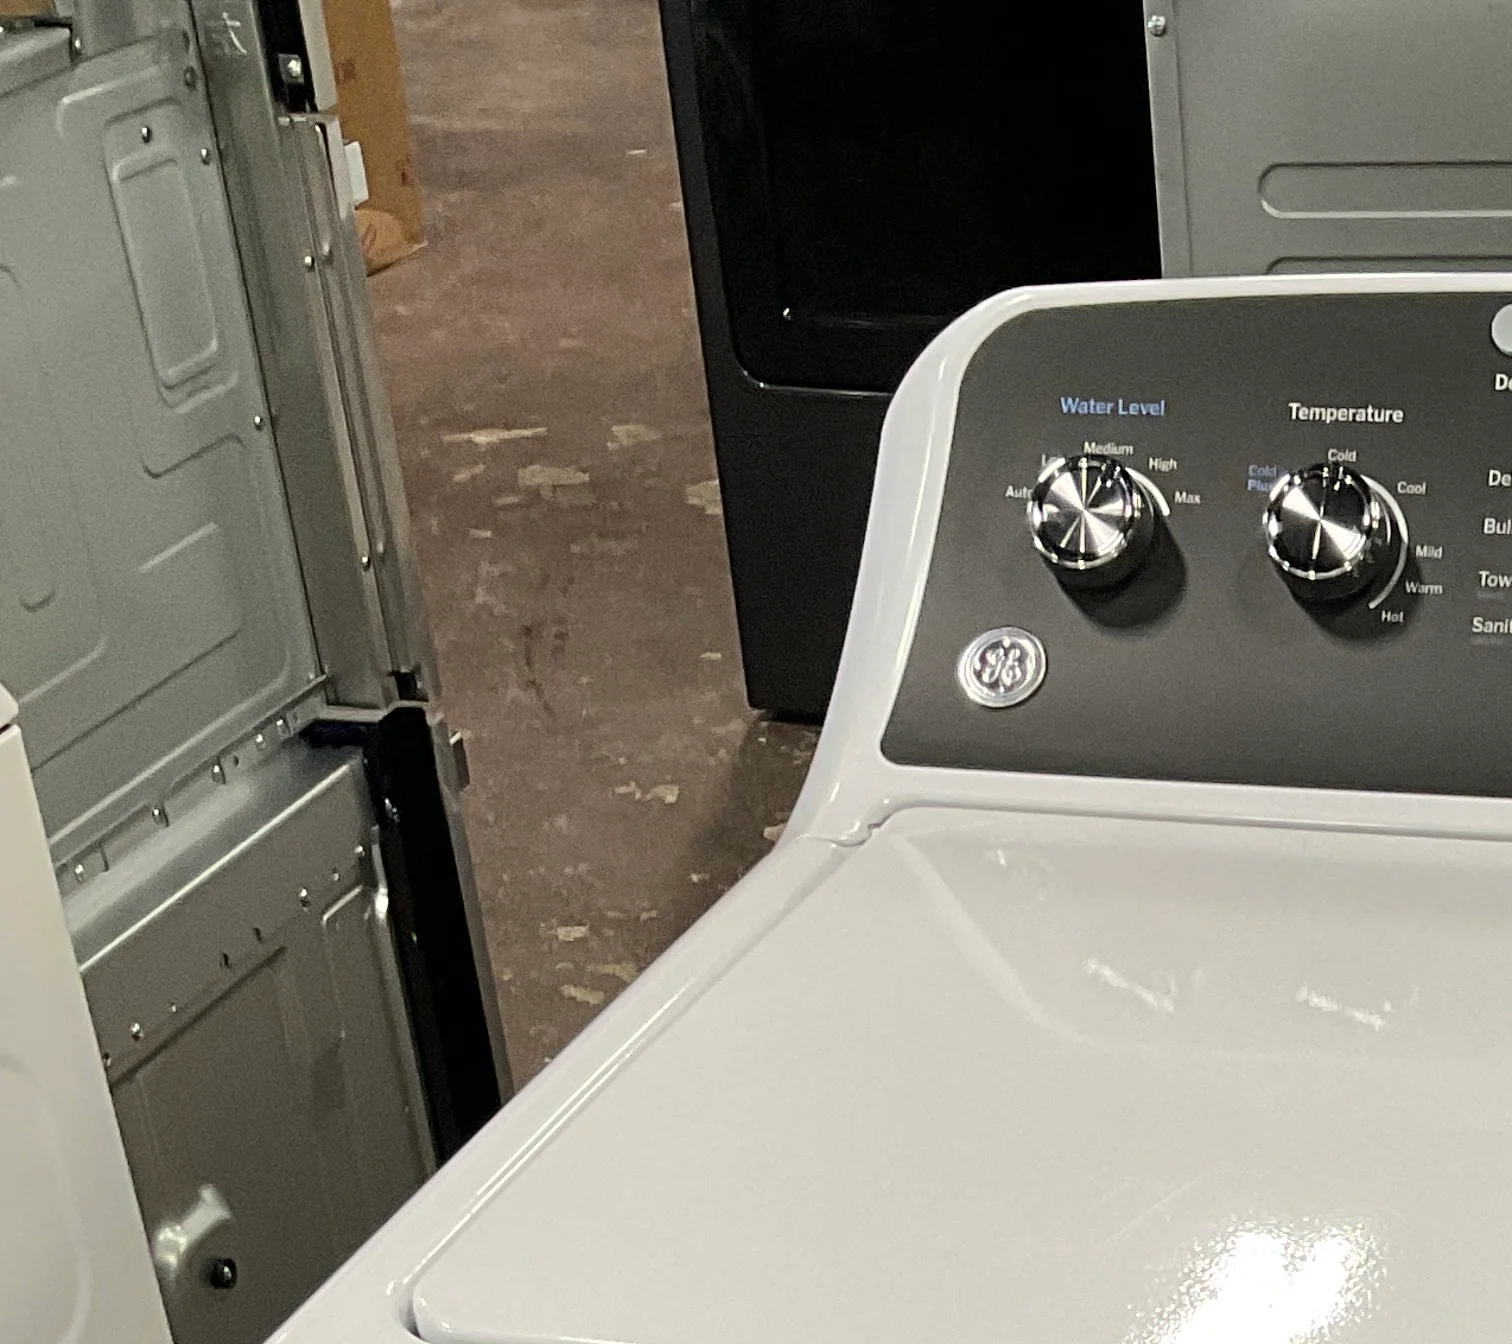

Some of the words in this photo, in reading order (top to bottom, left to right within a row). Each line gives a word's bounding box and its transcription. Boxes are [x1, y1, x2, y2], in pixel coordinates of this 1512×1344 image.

[1060, 397, 1113, 414] Water
[1119, 398, 1165, 416] Level
[1288, 402, 1404, 424] Temperature
[1083, 441, 1134, 455] Medium
[1327, 448, 1357, 462] Cold
[1149, 457, 1177, 473] High
[1397, 481, 1426, 495] Cool
[1174, 491, 1201, 504] Max
[1416, 545, 1443, 560] Mild
[1405, 581, 1443, 594] Warm
[1381, 610, 1404, 623] Hot
